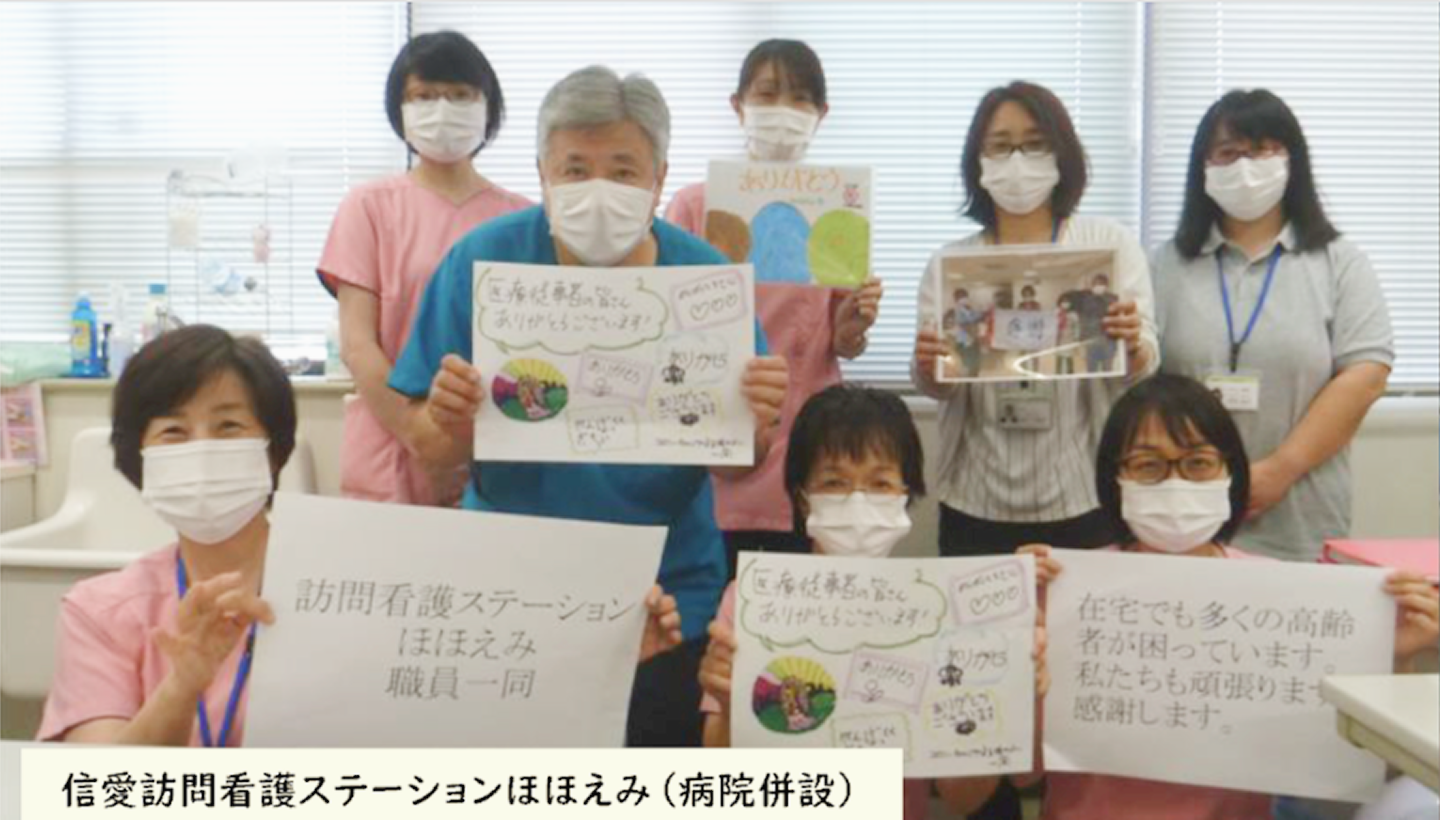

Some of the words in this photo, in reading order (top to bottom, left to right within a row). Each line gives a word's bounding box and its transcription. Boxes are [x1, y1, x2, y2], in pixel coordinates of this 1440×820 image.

[295, 578, 637, 622] 訪問看護ステーション
[1077, 592, 1355, 640] 在宅でも多くの高齢
[398, 627, 537, 661] ほほえみ
[1076, 628, 1336, 675] 者が困っています。
[385, 666, 537, 700] 職員一同
[1073, 694, 1232, 734] 感謝します。
